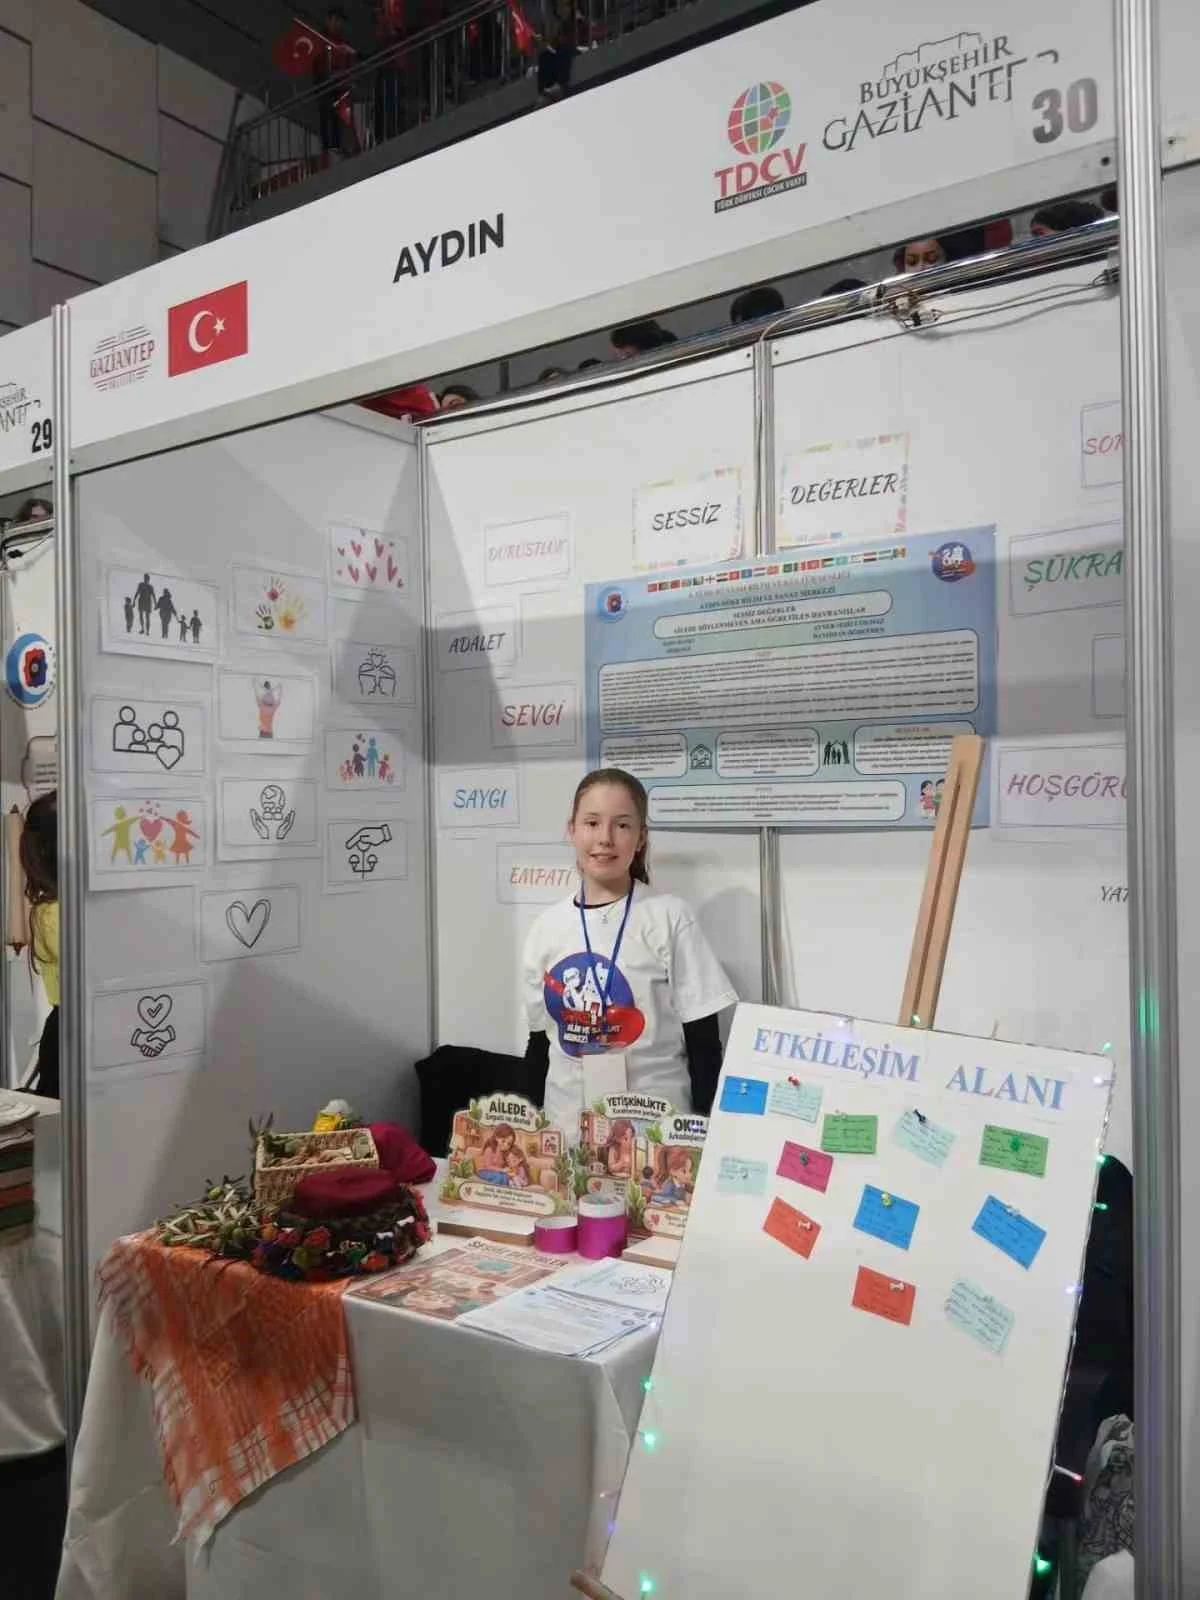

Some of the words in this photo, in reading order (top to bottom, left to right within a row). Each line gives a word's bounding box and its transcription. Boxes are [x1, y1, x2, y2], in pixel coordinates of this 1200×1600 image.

[859, 35, 1014, 104] BÜYÜKŞEHİR
[1032, 76, 1099, 144] 30
[714, 143, 806, 198] TDÇV
[393, 212, 504, 284] AYDIN
[89, 339, 155, 379] GAZİANTEP
[32, 418, 52, 453] 29
[652, 502, 722, 531] SESSİZ
[791, 473, 898, 505] DEĞERLER
[448, 632, 507, 654] ADALET
[501, 699, 567, 727] SEVGİ
[453, 789, 507, 809] SAYGI
[510, 865, 574, 887] EMPATİ
[752, 1026, 921, 1082] ETKİLEŞİM
[945, 1064, 1067, 1110] ALANI
[489, 1097, 527, 1117] AİLEDE
